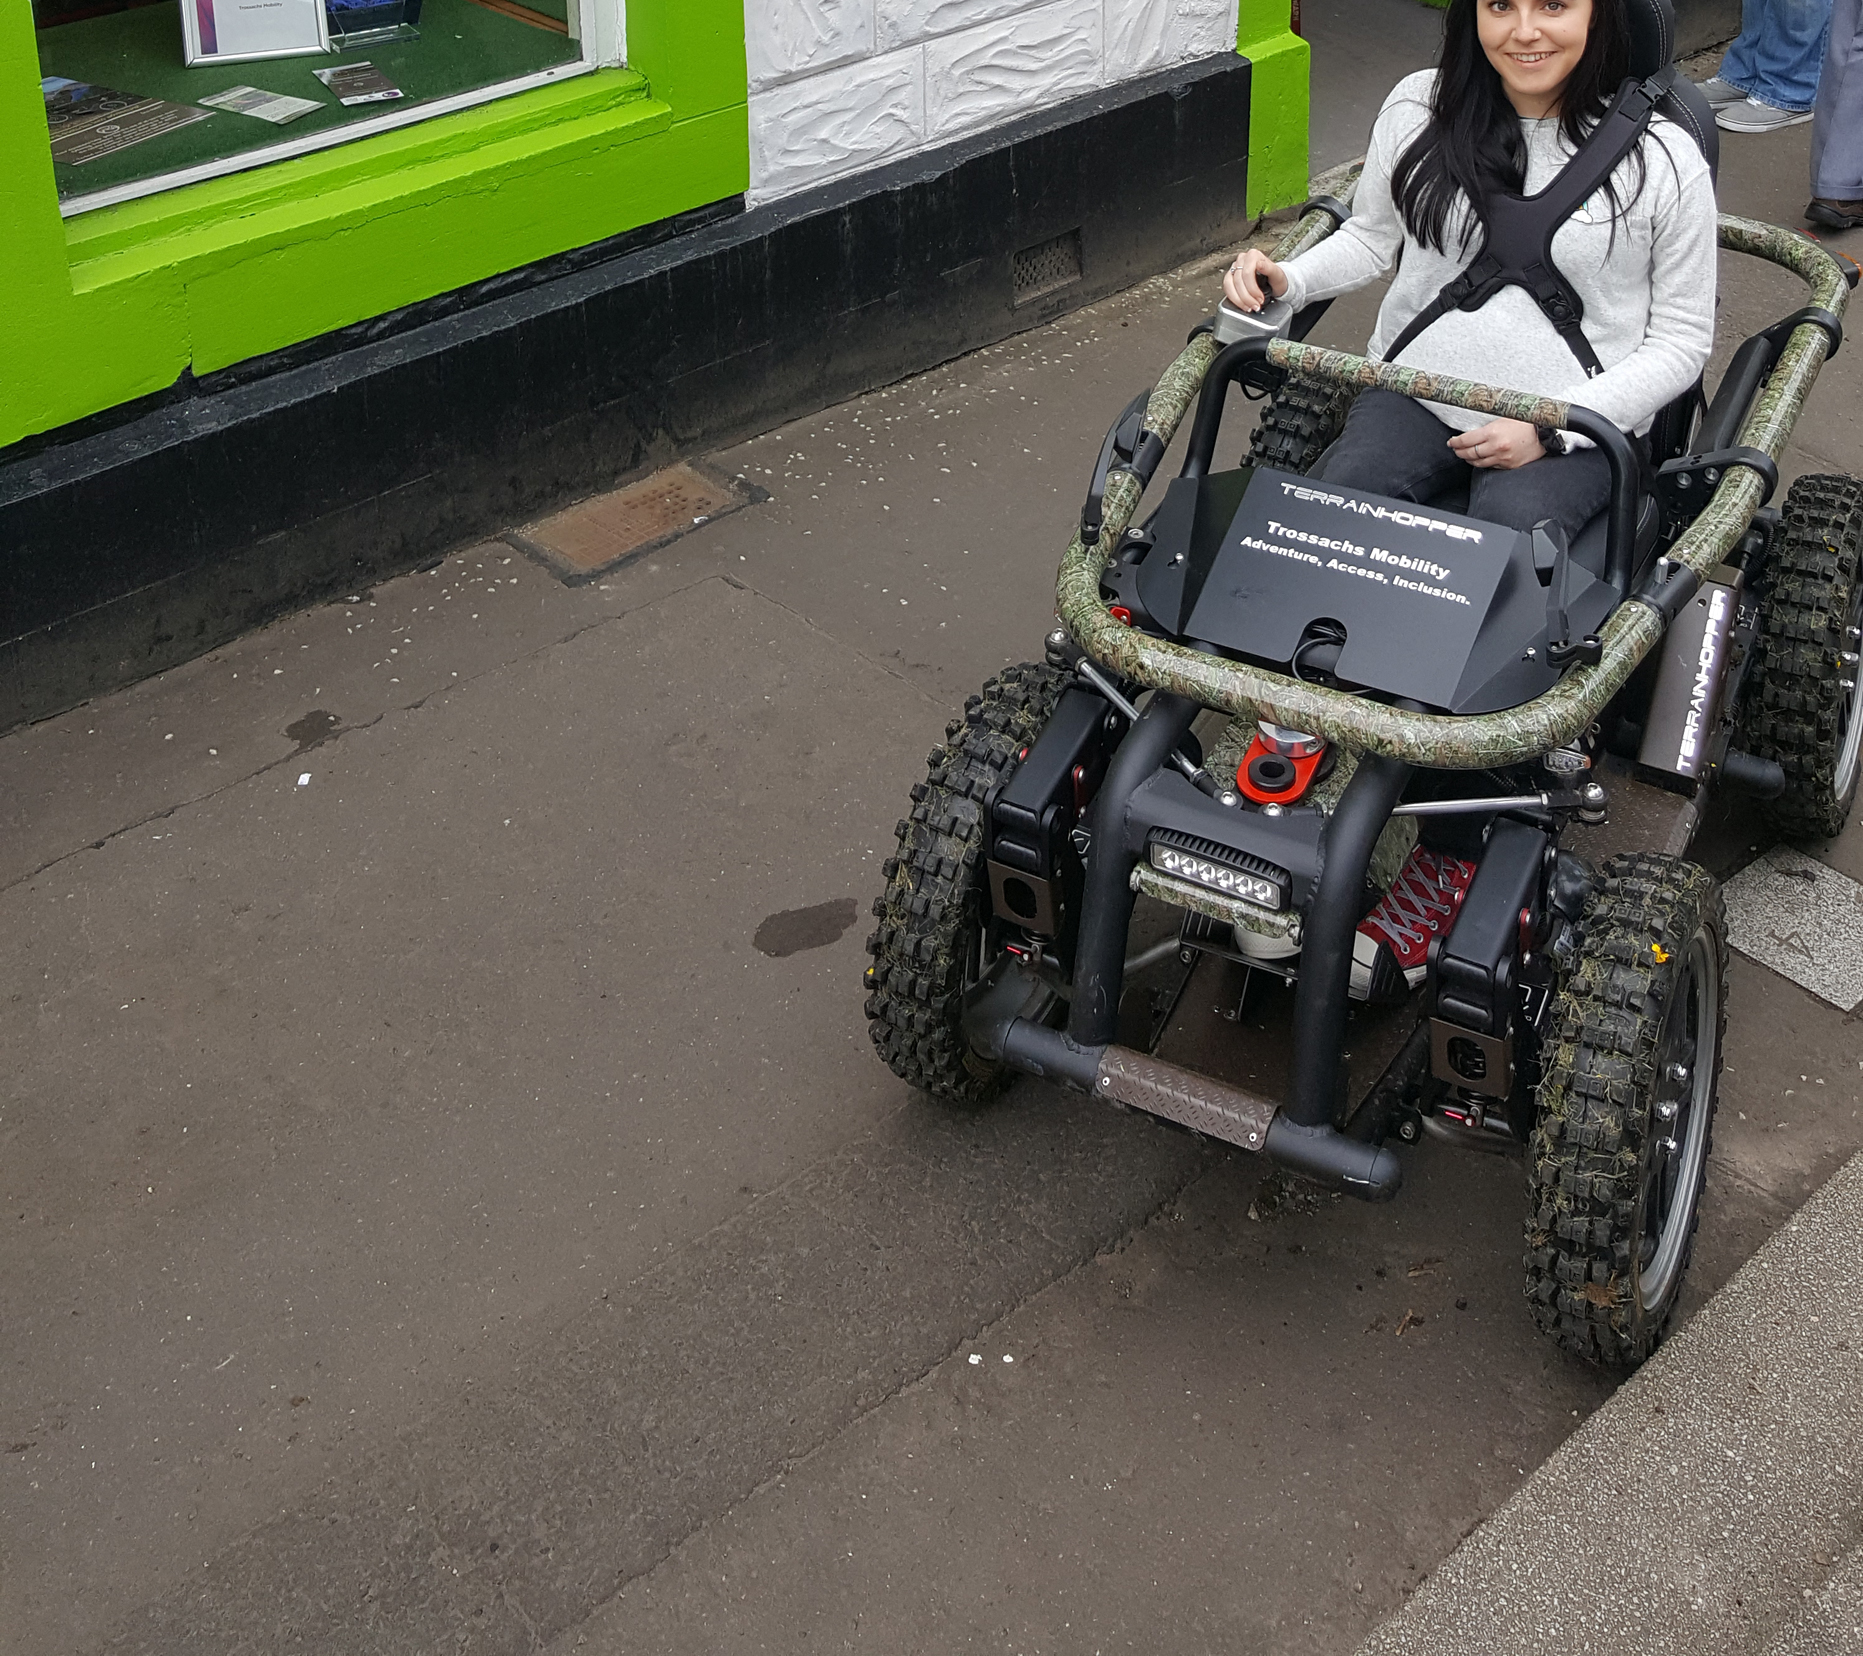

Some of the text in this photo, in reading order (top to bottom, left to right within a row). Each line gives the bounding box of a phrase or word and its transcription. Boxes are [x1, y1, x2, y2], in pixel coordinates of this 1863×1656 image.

[1280, 482, 1484, 546] TERRAINHOPPER
[1240, 536, 1472, 606] Adventure, Access, Inclusion.
[1267, 520, 1452, 582] Trossachs Mobility
[1676, 589, 1727, 771] TERRAINHOPPER
